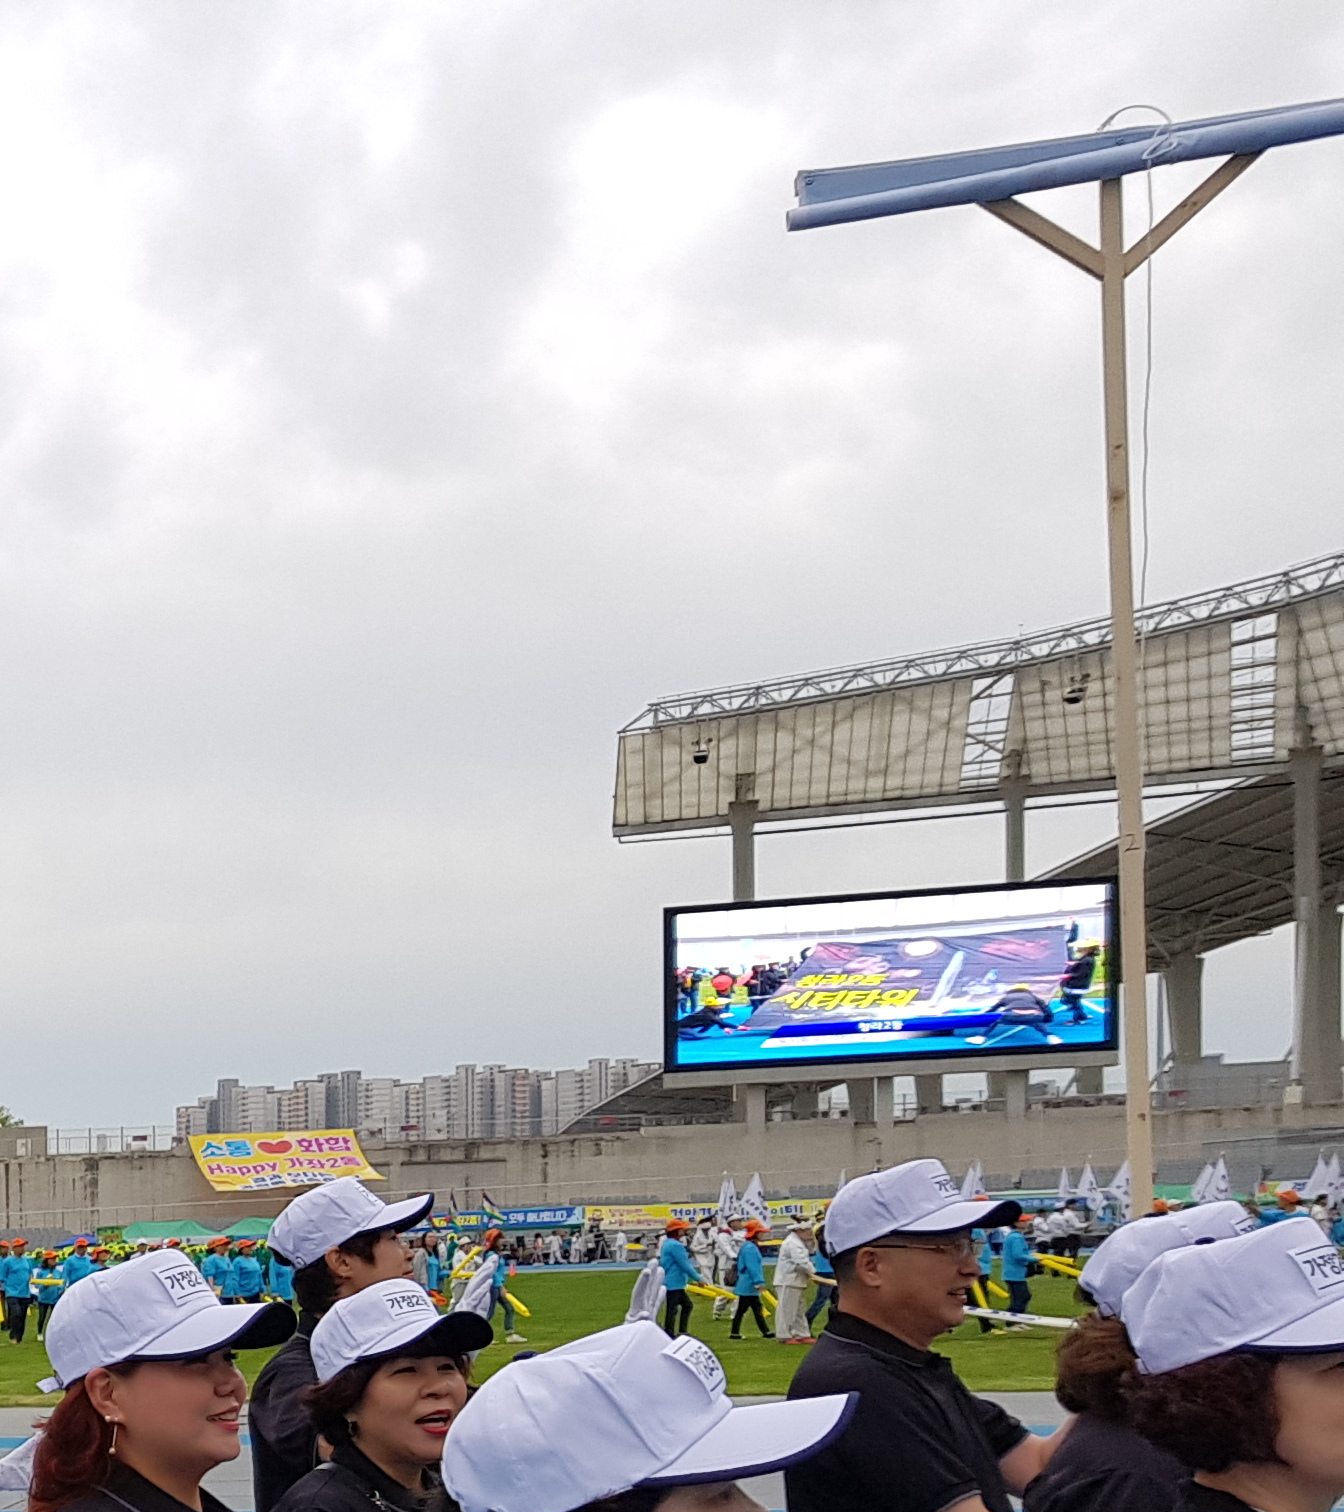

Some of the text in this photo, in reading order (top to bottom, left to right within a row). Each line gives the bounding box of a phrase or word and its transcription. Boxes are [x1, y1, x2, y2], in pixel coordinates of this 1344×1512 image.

[770, 989, 920, 1010] 시티타워
[200, 1137, 352, 1159] 소통 화합
[207, 1161, 279, 1176] Happy
